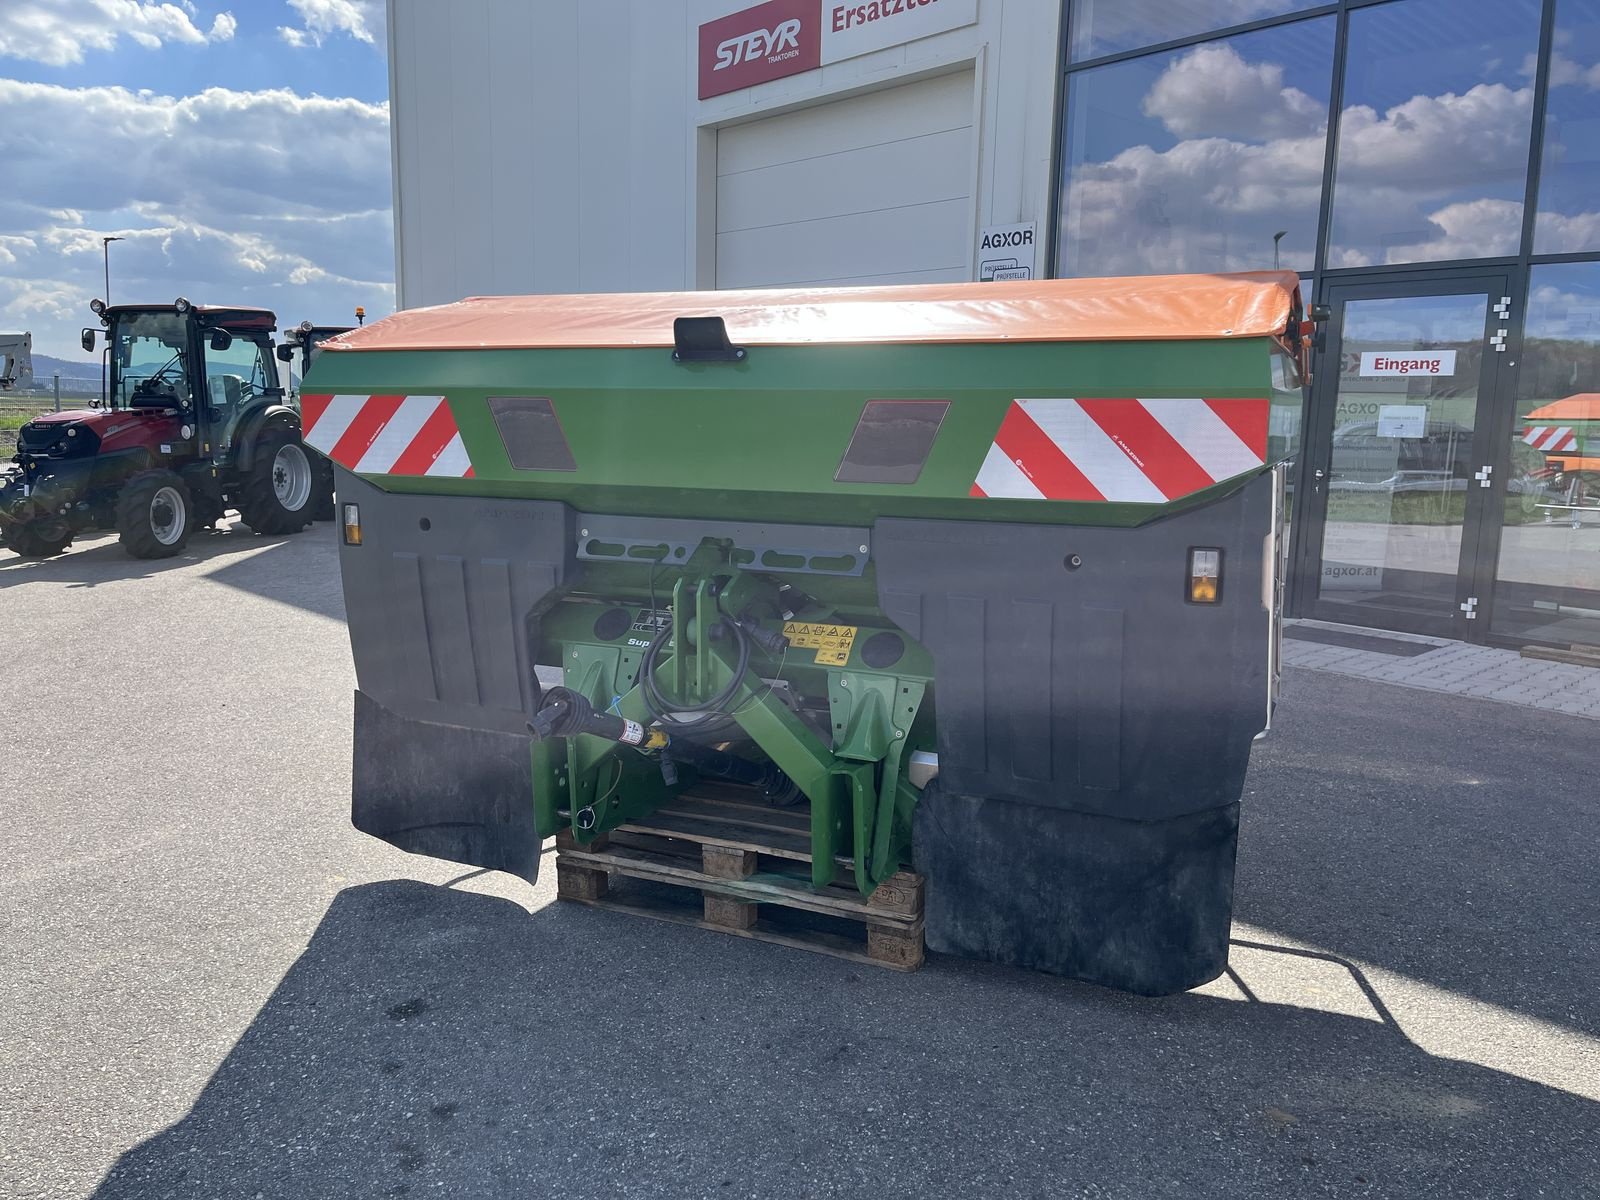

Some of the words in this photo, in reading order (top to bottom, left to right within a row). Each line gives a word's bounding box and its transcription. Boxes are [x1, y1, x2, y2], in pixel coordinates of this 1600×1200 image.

[832, 0, 938, 33] Ersatz
[713, 18, 801, 71] STEYR
[767, 49, 800, 64] TRAKTOREN
[981, 230, 1033, 249] AGXOR
[1374, 357, 1441, 374] Eingang
[1336, 402, 1378, 415] AGXO
